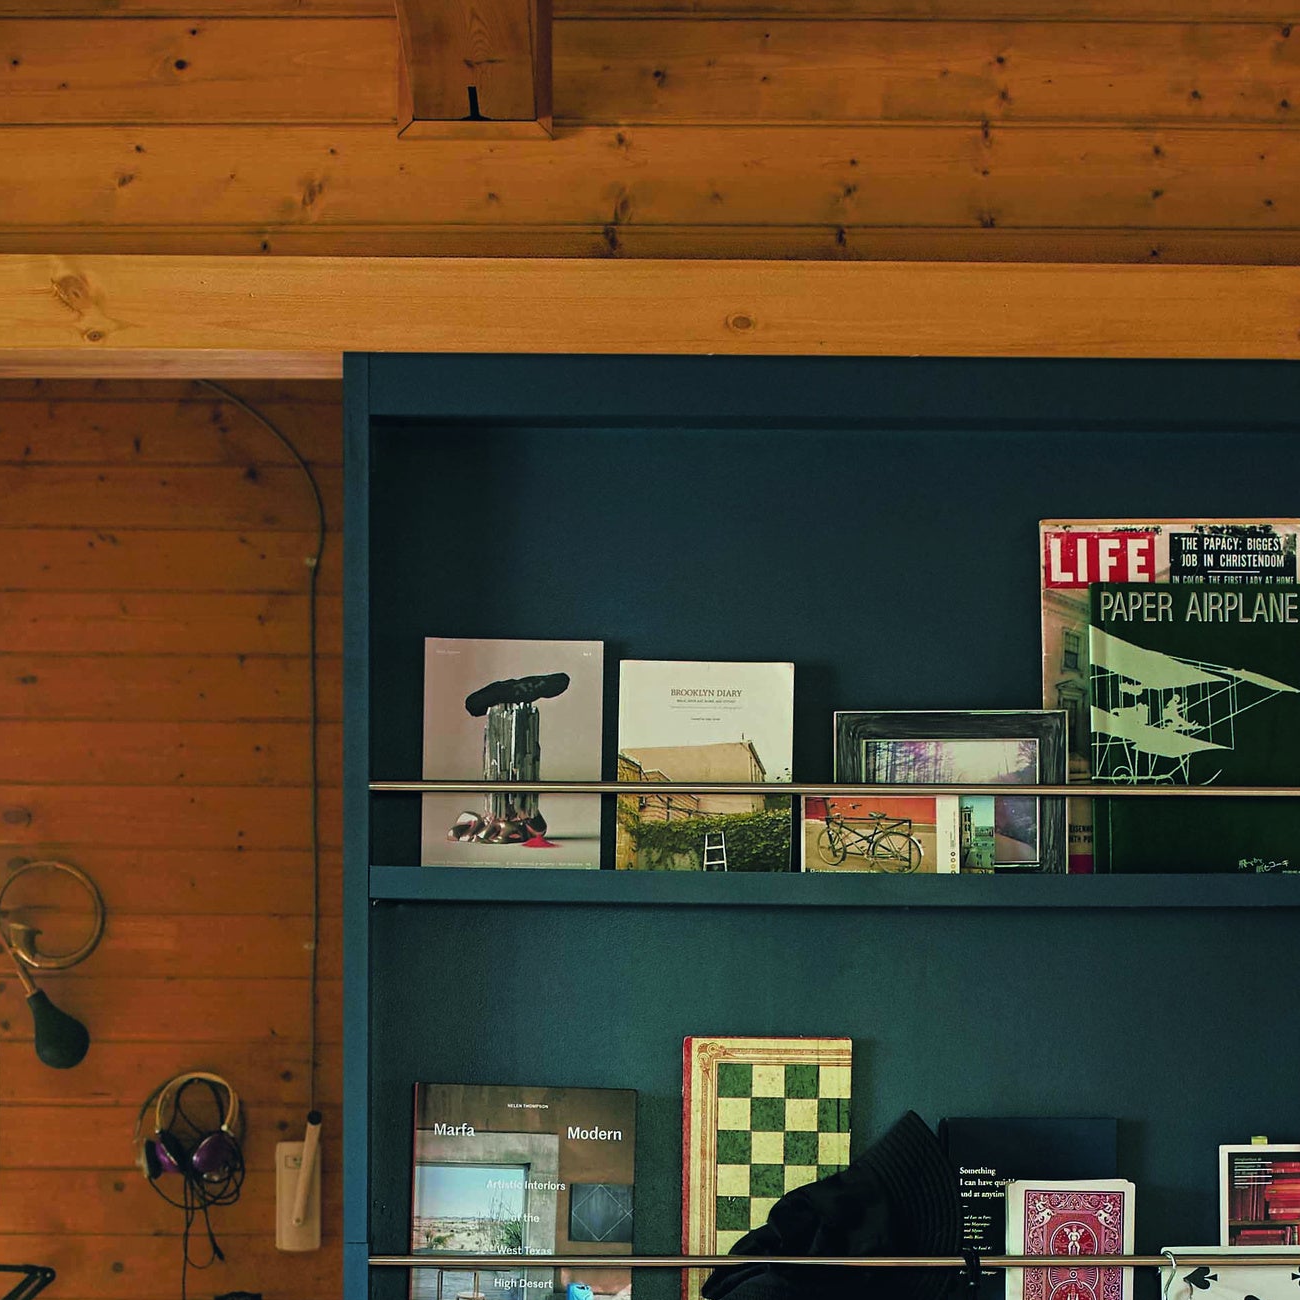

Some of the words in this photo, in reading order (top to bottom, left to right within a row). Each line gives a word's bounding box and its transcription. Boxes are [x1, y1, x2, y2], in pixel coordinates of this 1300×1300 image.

[1181, 537, 1198, 551] THE
[1203, 537, 1243, 551] PAPACY:
[1246, 537, 1284, 551] BIGGEST
[1050, 538, 1150, 583] LIFE
[1181, 553, 1198, 568] JOB
[1203, 553, 1214, 567] IN
[1219, 553, 1285, 568] CHRISTENDOM
[1100, 592, 1173, 622] PAPER
[1185, 592, 1299, 623] AIRPLANE
[670, 688, 715, 697] BROOKLYN
[716, 689, 743, 697] DIARY
[434, 1123, 475, 1137] Marfa
[567, 1126, 622, 1141] Modern
[959, 1167, 997, 1177] Something
[486, 1179, 522, 1190] Artistic
[524, 1180, 566, 1191] Interiors
[959, 1178, 963, 1186] I
[978, 1178, 993, 1186] have
[973, 1190, 980, 1198] at
[511, 1213, 521, 1222] of
[523, 1213, 540, 1223] the
[497, 1245, 522, 1255] West
[524, 1245, 552, 1255] Texas
[494, 1278, 517, 1289] High
[519, 1278, 553, 1289] Desert
